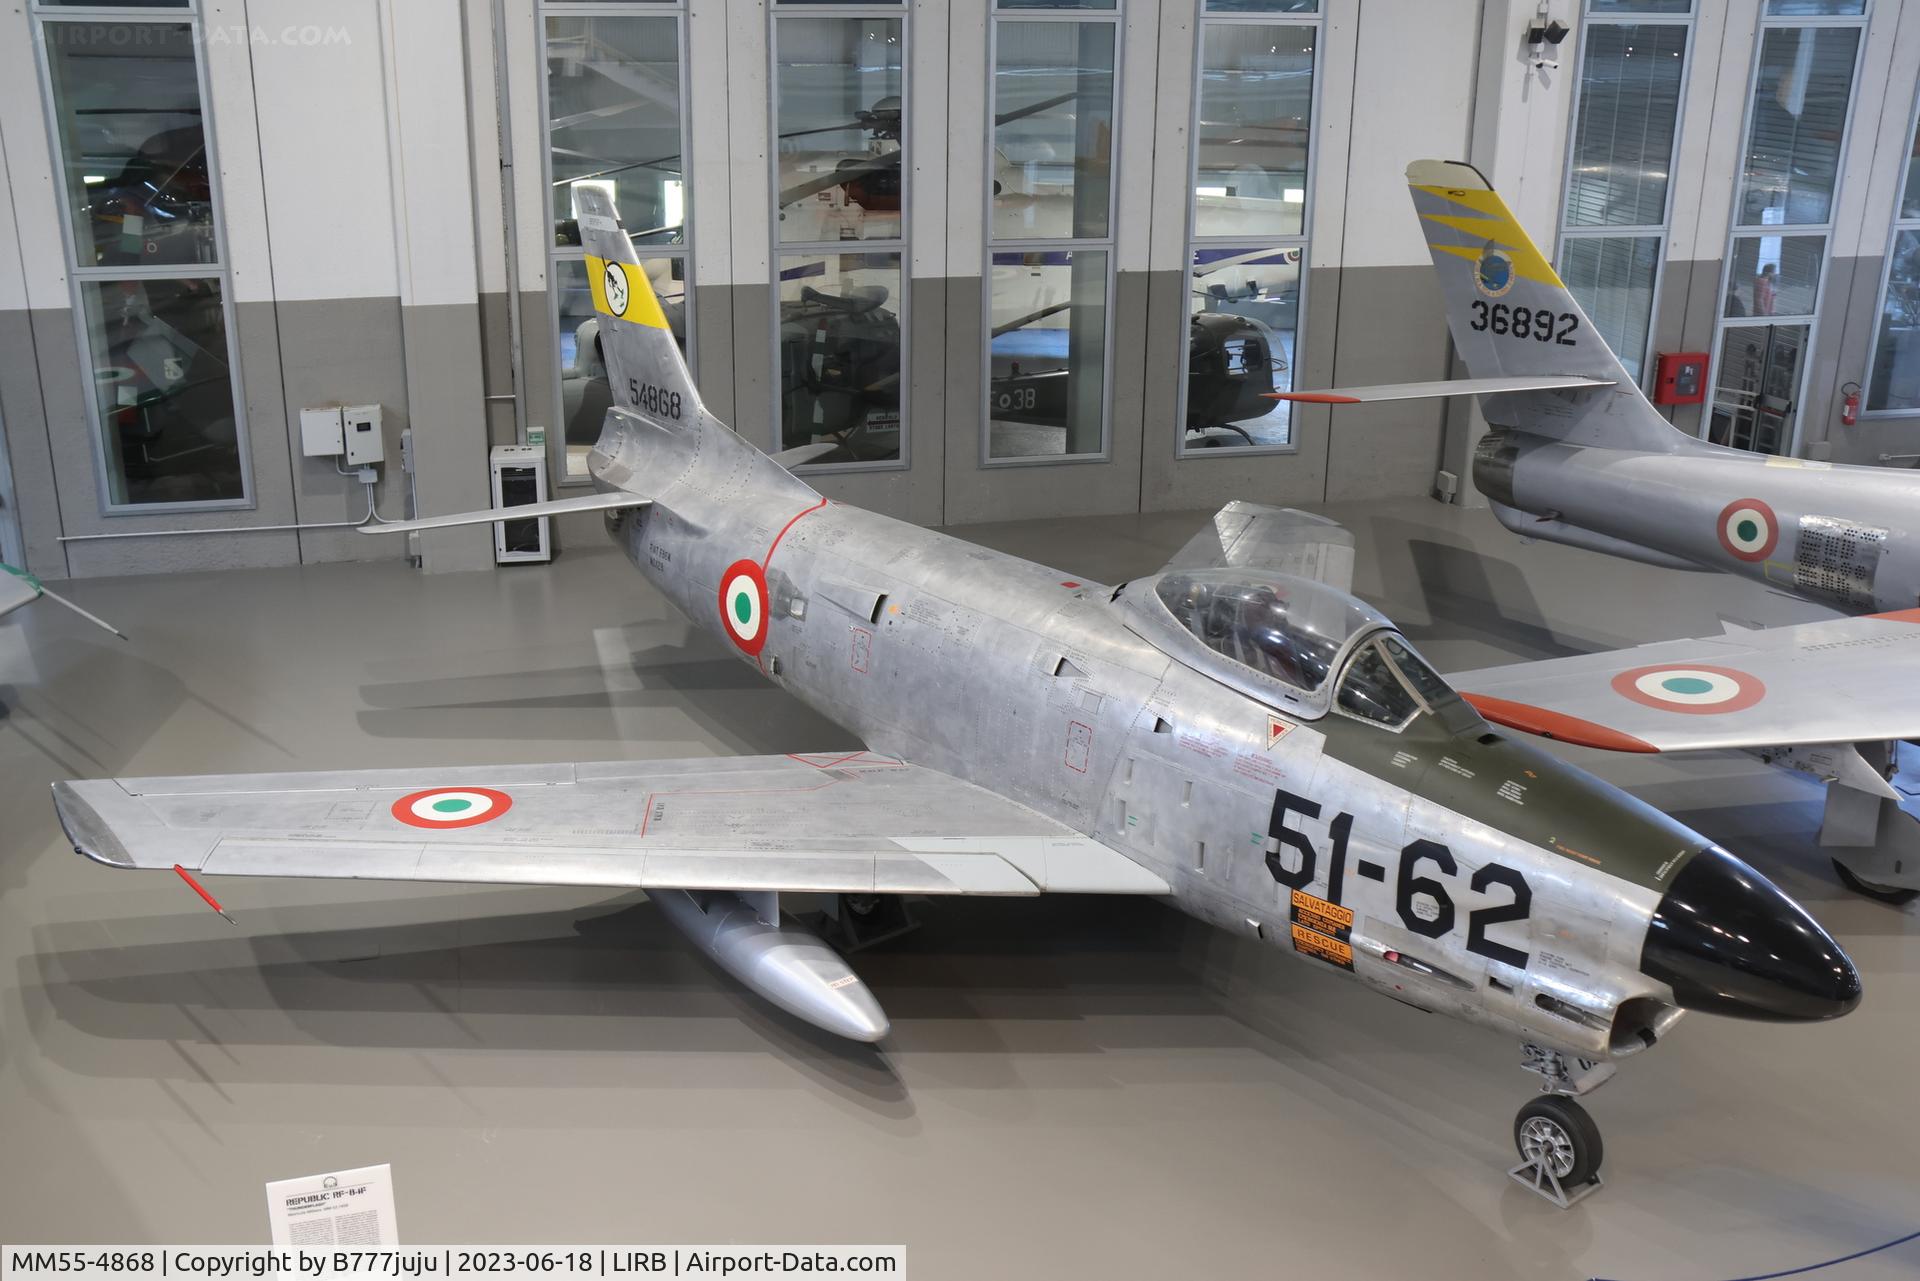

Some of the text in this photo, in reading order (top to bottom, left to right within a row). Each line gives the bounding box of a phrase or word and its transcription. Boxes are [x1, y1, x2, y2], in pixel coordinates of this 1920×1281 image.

[1470, 300, 1579, 346] 36892
[629, 378, 681, 420] 54868
[1265, 788, 1532, 970] 51-62
[1293, 892, 1352, 924] SALVATAGGIO
[1297, 928, 1345, 953] RESCUE
[286, 1192, 330, 1207] REPUBLIC
